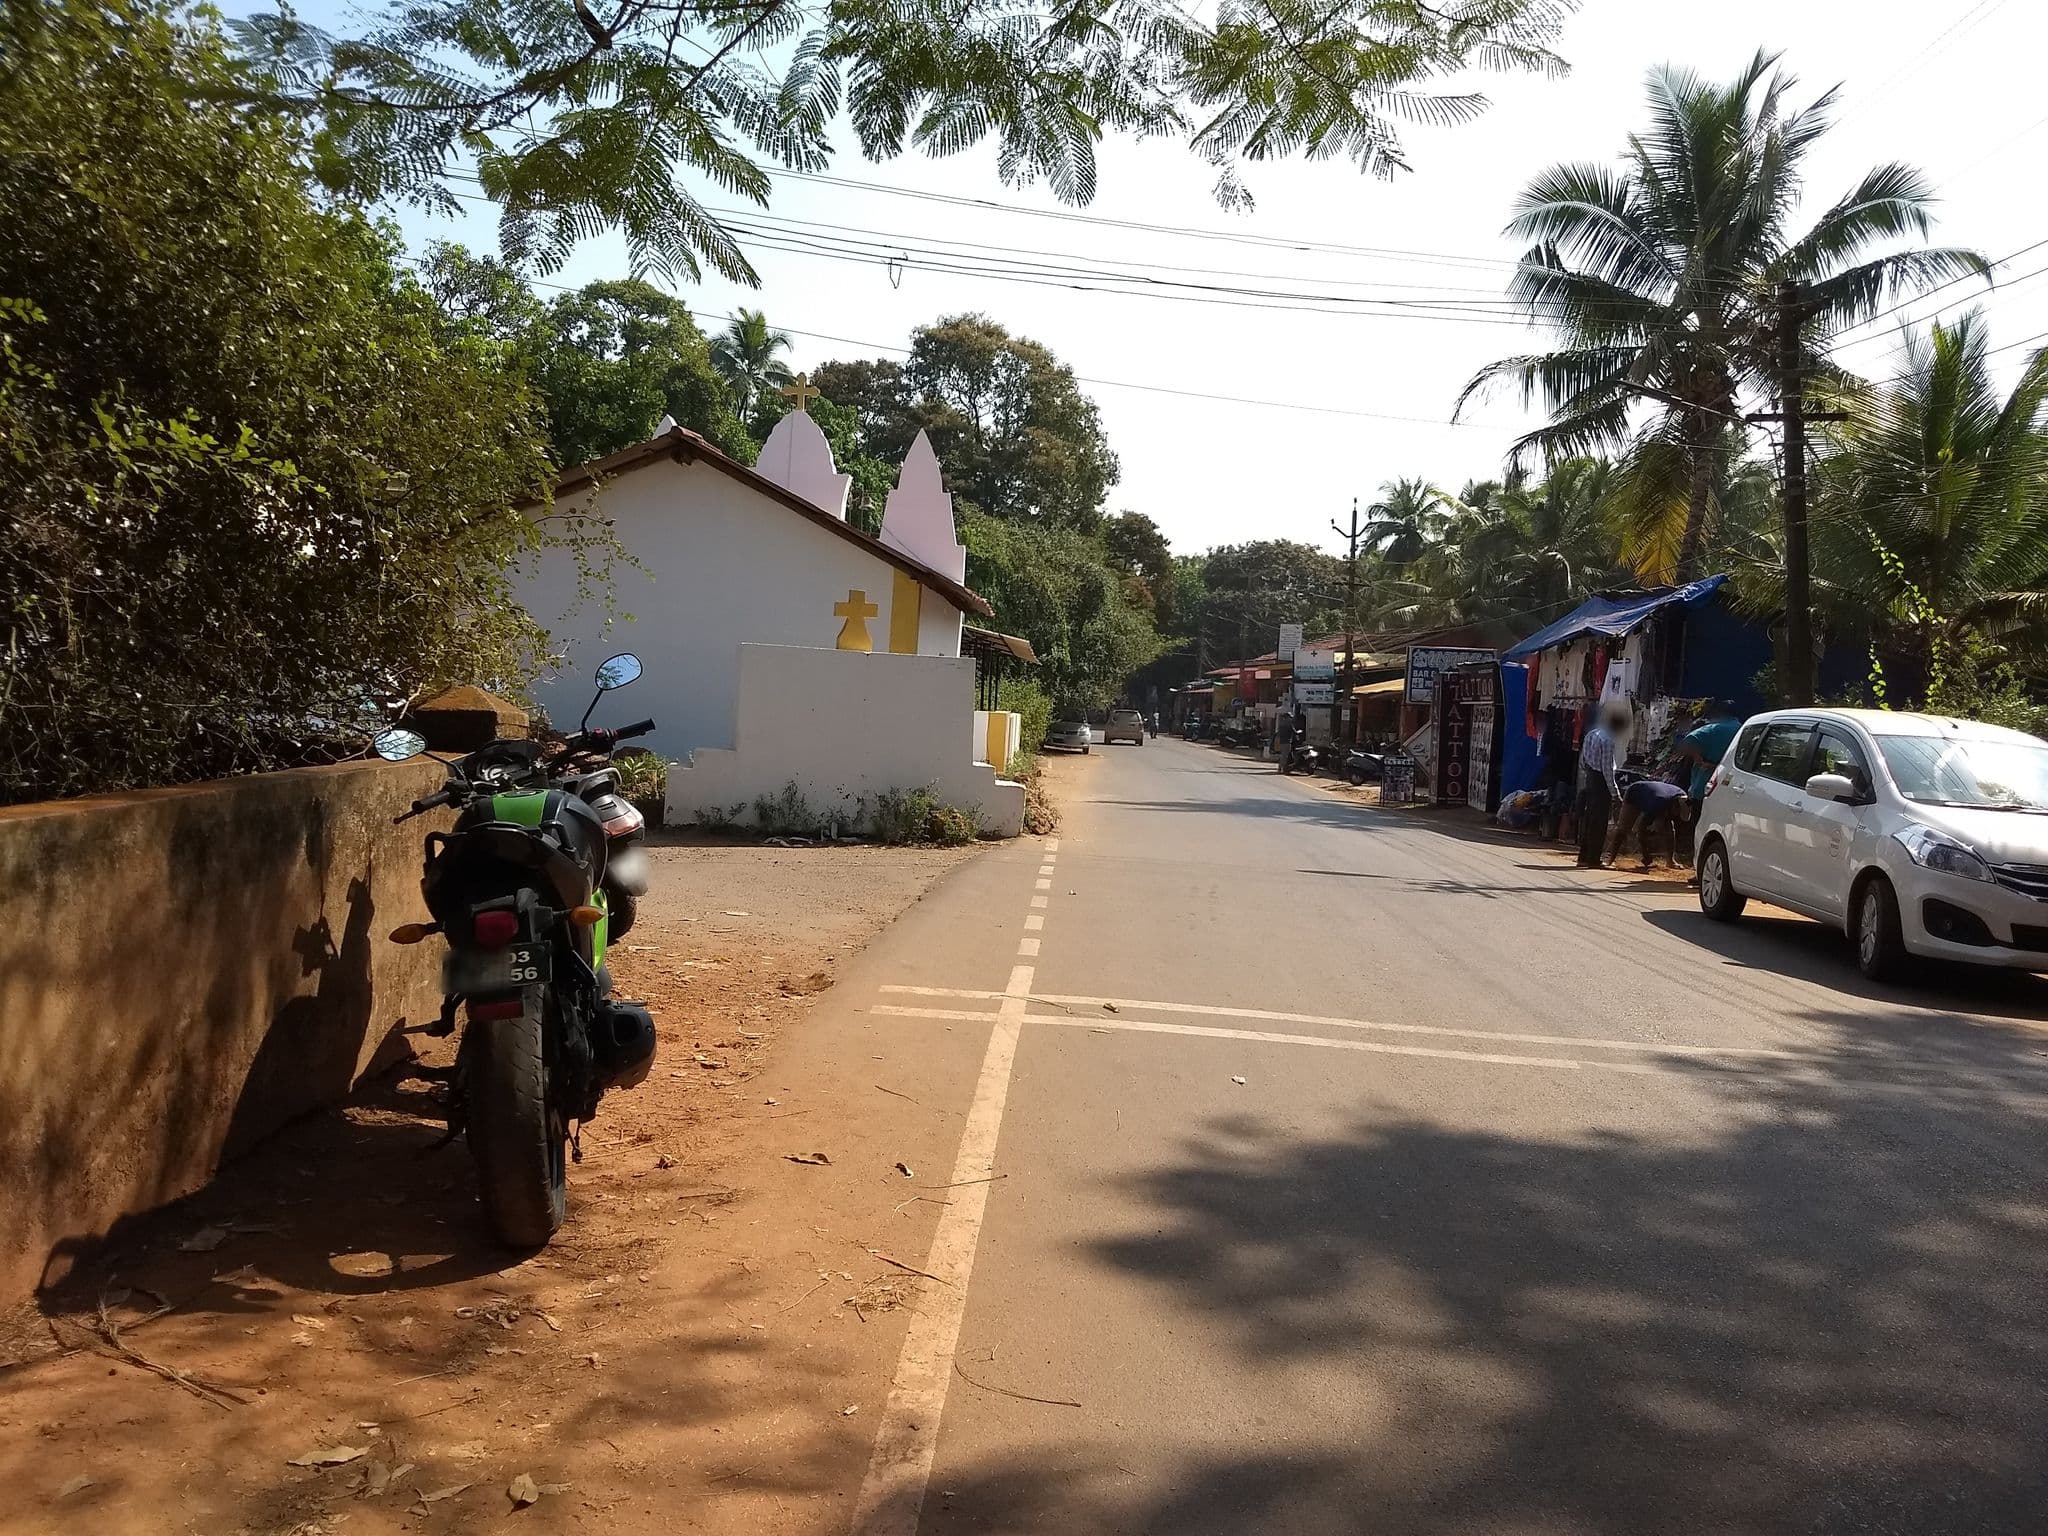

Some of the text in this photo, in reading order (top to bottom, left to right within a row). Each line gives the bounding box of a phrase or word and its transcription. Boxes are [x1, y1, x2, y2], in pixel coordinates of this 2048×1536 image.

[1412, 669, 1429, 678] BAR
[1459, 678, 1494, 698] TATTOO
[1447, 685, 1465, 797] TATTOO
